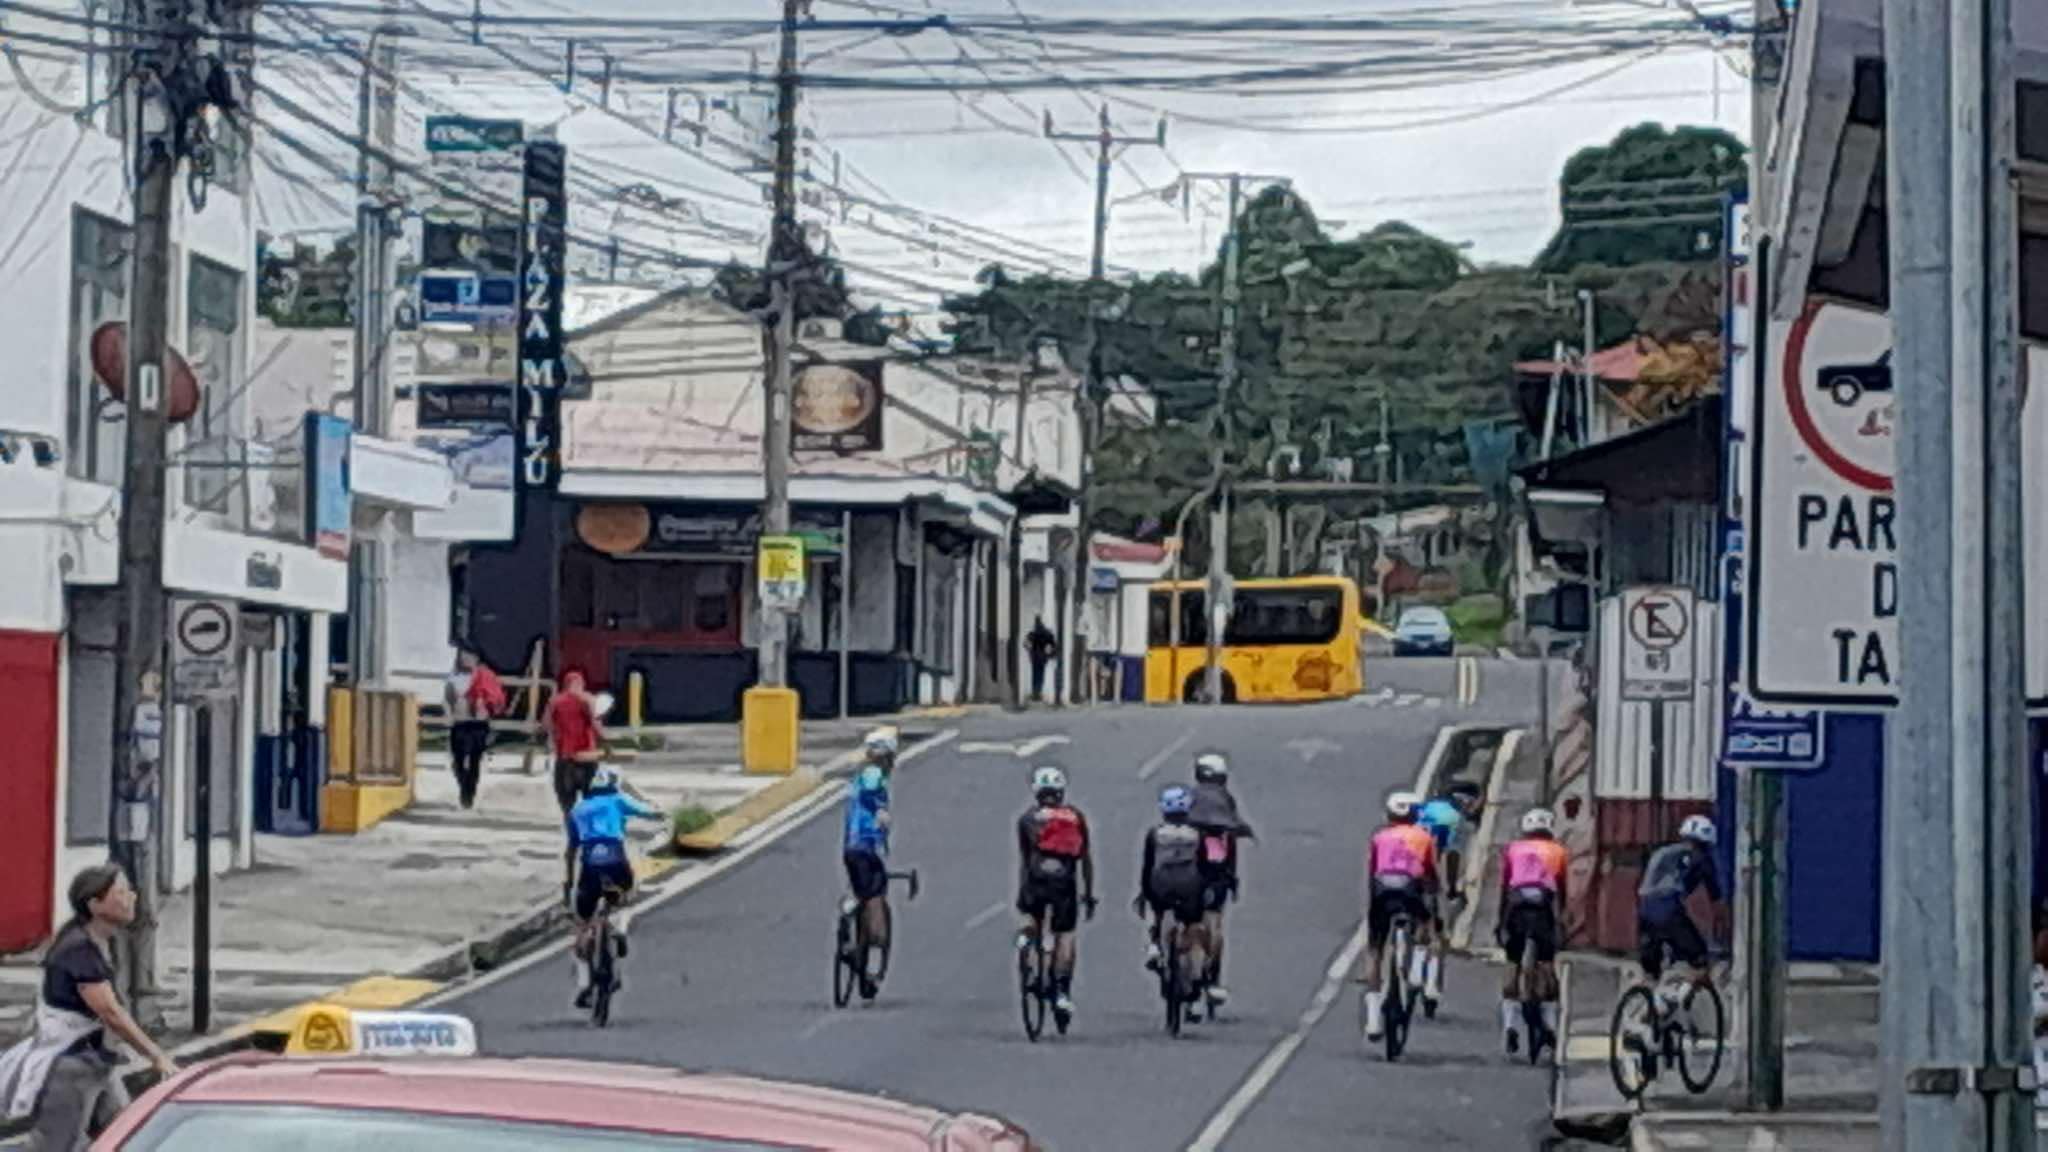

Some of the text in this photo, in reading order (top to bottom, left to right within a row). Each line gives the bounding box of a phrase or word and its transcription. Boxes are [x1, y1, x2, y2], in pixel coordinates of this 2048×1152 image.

[526, 198, 551, 339] PLAZA
[1798, 495, 1897, 550] PAR
[1874, 562, 1897, 617] D
[1832, 628, 1893, 684] TA
